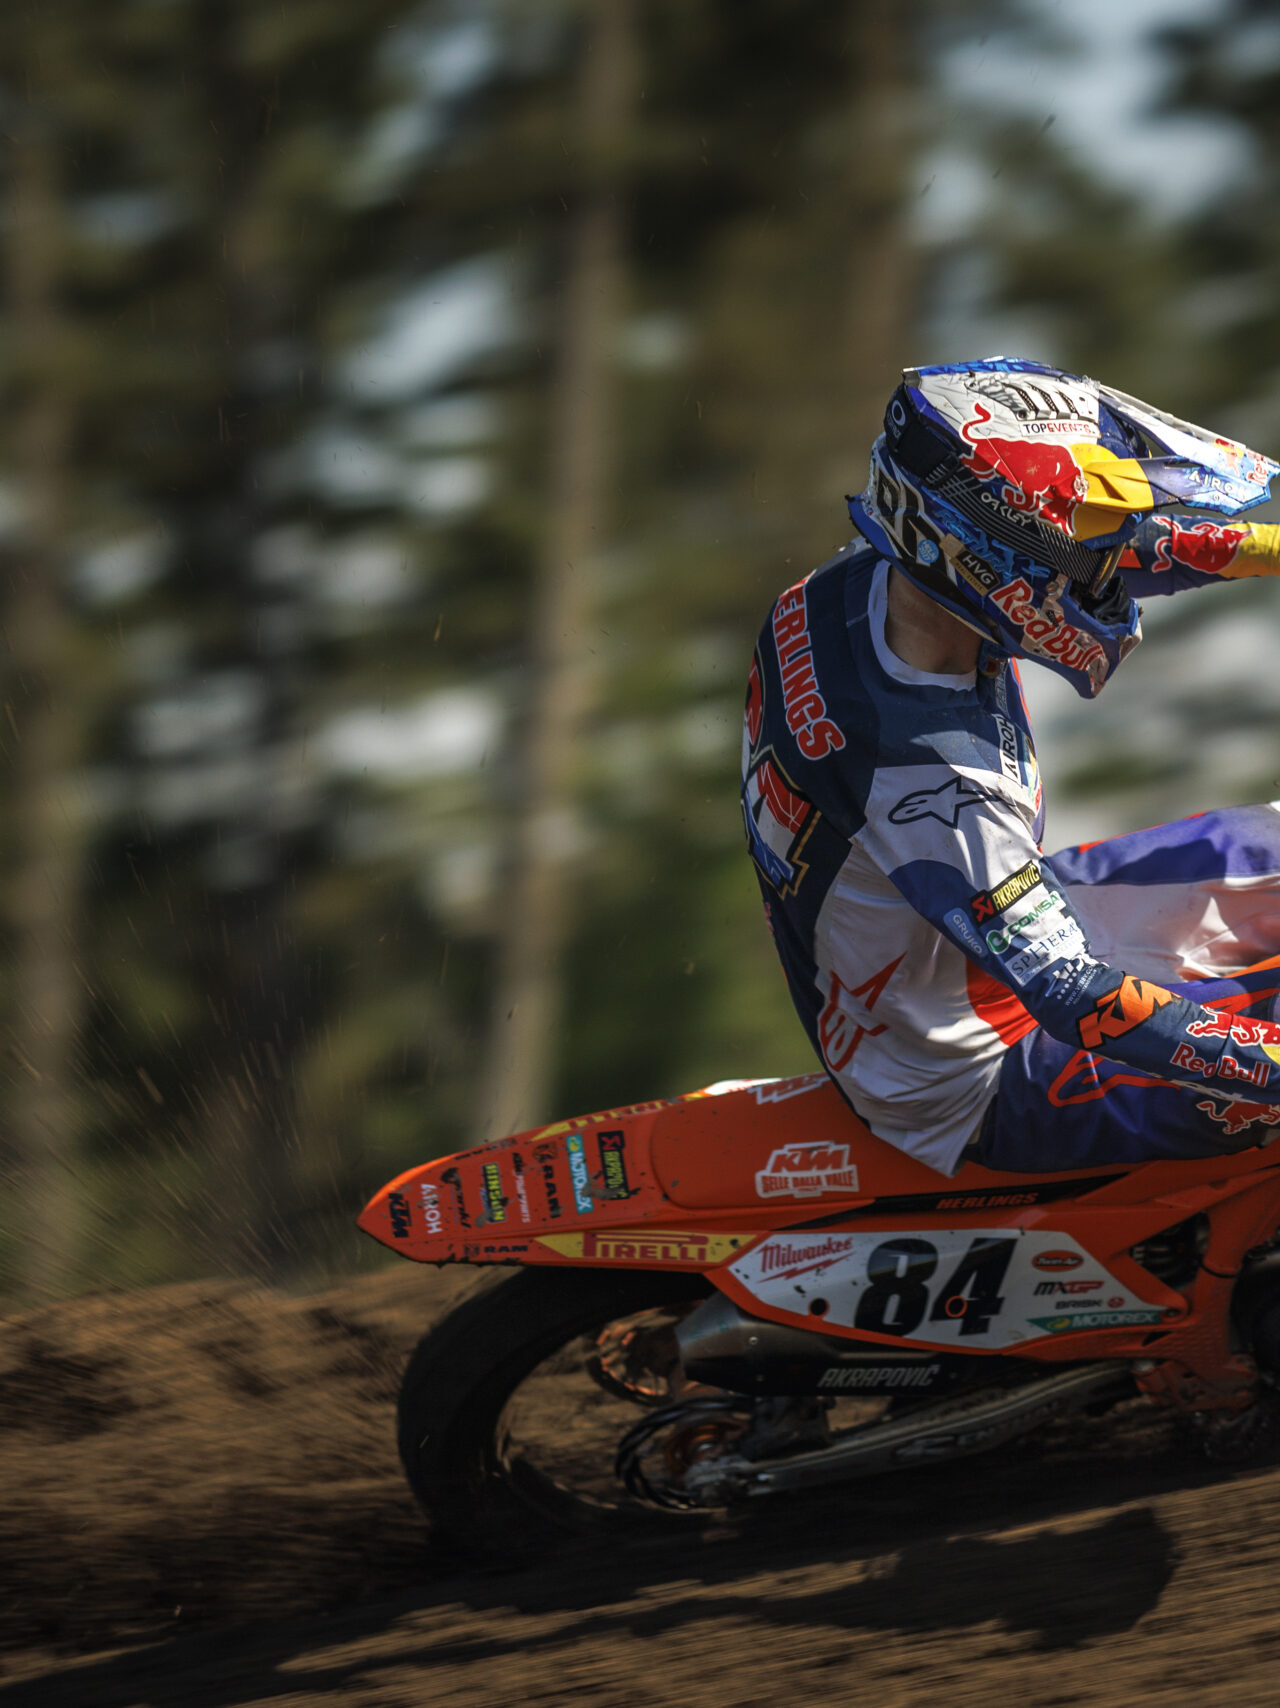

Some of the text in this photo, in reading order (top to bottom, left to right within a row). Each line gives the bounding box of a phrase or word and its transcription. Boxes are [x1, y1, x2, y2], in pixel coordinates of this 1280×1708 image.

[980, 492, 1032, 527] OAKLEY
[962, 553, 995, 586] HVG
[989, 577, 1105, 672] Red Bull
[771, 570, 847, 761] ERLINGS
[952, 914, 982, 955] GRUKO
[1007, 893, 1060, 936] COMISA
[1011, 922, 1078, 976] SPHERA
[1076, 971, 1182, 1049] KTM
[1170, 1043, 1272, 1088] Red Bull
[768, 1143, 848, 1175] KTM
[825, 1168, 855, 1188] VALLE
[484, 1163, 506, 1222] HINSON
[542, 1165, 561, 1218] RAM
[571, 1151, 593, 1212] MOTOREX
[936, 1192, 1039, 1209] HERLINGS
[388, 1192, 413, 1238] KTM
[420, 1183, 442, 1234] AIROH
[483, 1244, 529, 1254] RAM
[583, 1232, 709, 1262] PIRELLI
[757, 1237, 853, 1273] Milwaukee
[854, 1237, 1018, 1338] 84
[1033, 1280, 1104, 1296] MXGP
[1055, 1300, 1103, 1310] BRISK
[1072, 1311, 1158, 1328] MOTOREX
[817, 1364, 940, 1388] AKRAPOVIČ
